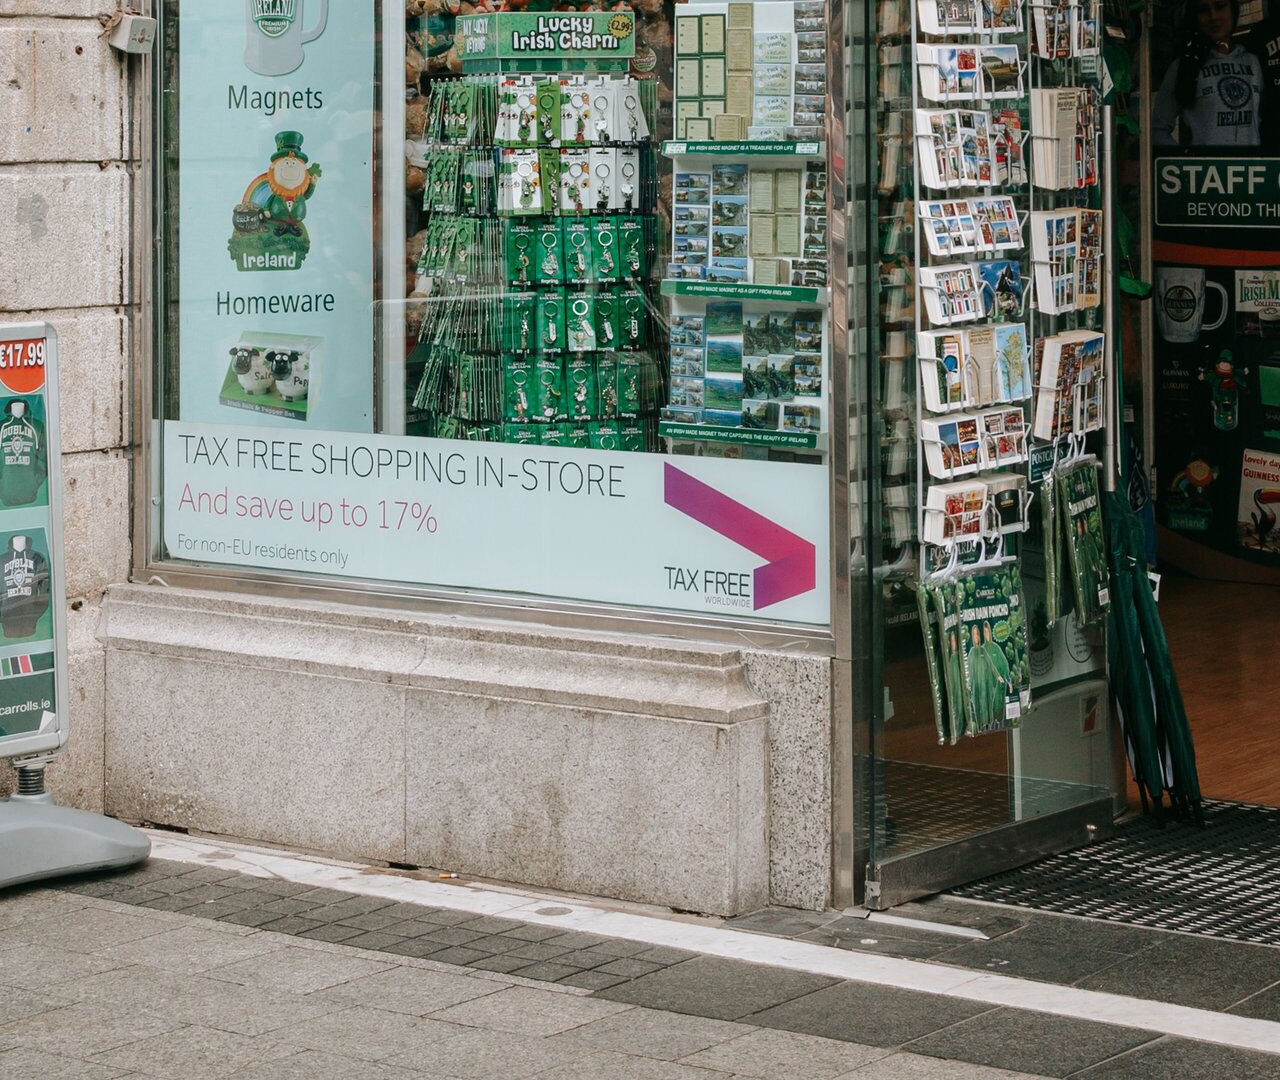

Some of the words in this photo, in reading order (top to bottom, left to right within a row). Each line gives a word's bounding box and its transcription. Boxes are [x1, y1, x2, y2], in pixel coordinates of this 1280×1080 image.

[537, 16, 593, 34] Lucky
[611, 20, 631, 32] €2.99
[512, 30, 555, 50] Irish
[228, 85, 323, 116] Magnets
[1161, 165, 1266, 195] STAFF
[1187, 202, 1252, 217] BEYOND
[242, 252, 297, 268] Ireland
[217, 291, 335, 315] Homeware
[178, 434, 229, 466] TAX
[237, 438, 303, 472] FREE
[311, 443, 466, 485] SHOPPING
[476, 456, 625, 497] IN-STORE
[1244, 454, 1267, 466] Lovely
[1243, 467, 1280, 482] GUINNESS
[178, 483, 228, 515] And
[235, 493, 293, 520] save
[301, 500, 333, 531] up
[340, 498, 368, 527] to
[378, 499, 438, 533] 17%
[178, 533, 198, 551] For
[201, 538, 251, 556] non-EU
[255, 542, 317, 562] residents
[320, 548, 349, 569] only
[664, 566, 699, 593] TAX
[704, 570, 751, 597] FREE
[704, 596, 751, 608] WORLDWIDE
